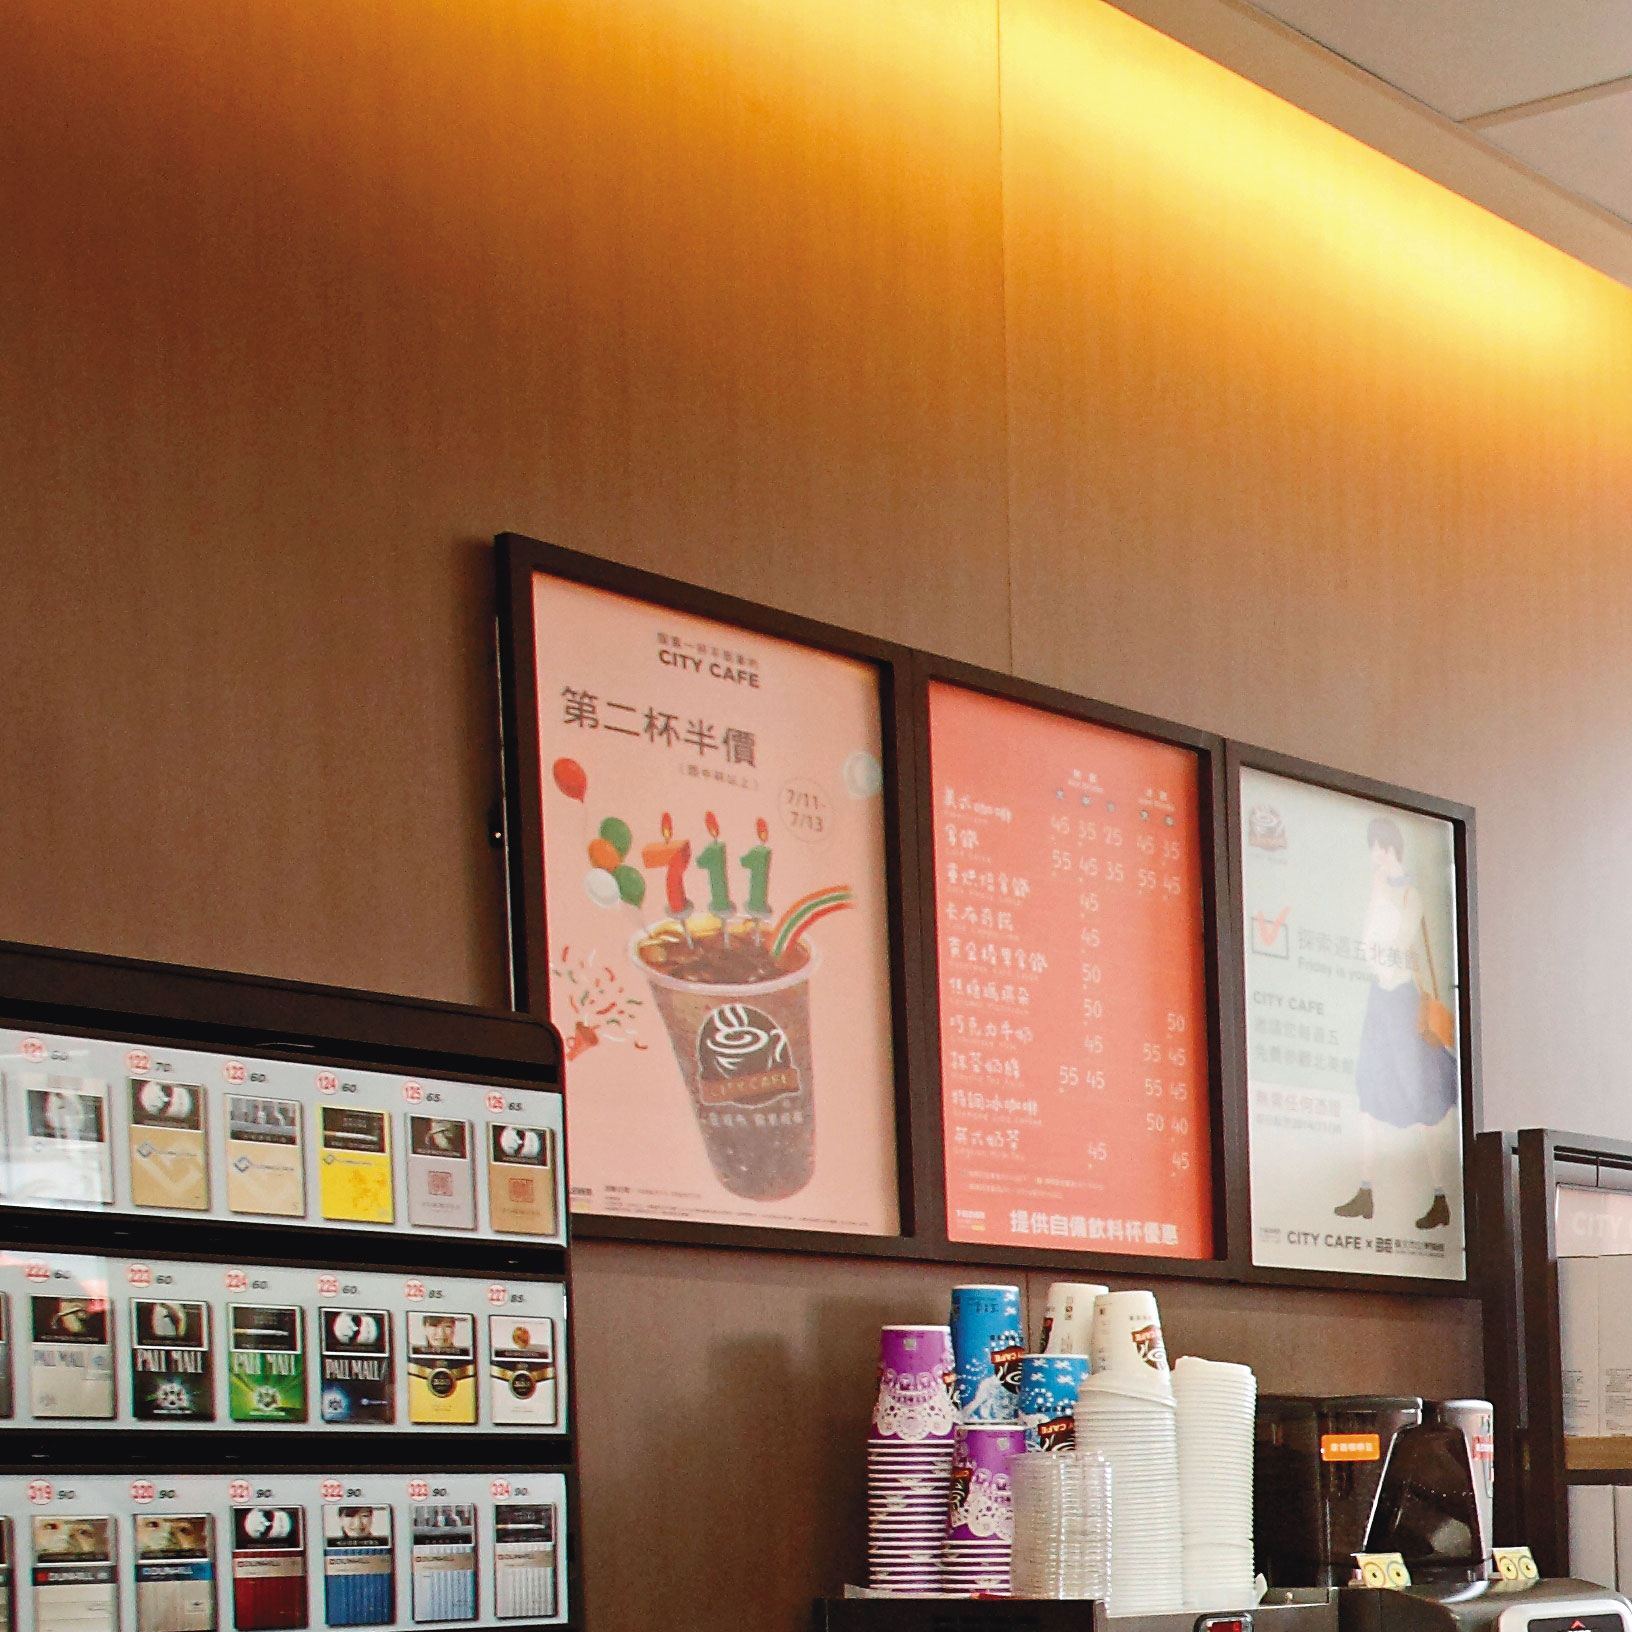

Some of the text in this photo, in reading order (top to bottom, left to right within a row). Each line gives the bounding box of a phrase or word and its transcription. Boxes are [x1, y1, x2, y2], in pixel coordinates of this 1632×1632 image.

[658, 649, 702, 673] CITY
[709, 662, 760, 689] CAFE
[561, 685, 757, 769] 第二杯半價
[1252, 990, 1325, 1017] CITY CAFE
[1059, 1064, 1080, 1087] 55
[1086, 1070, 1106, 1091] 45
[1009, 1208, 1180, 1247] 提供自備飲料杯優惠
[1571, 1211, 1623, 1240] CITY
[1287, 1230, 1362, 1251] CITY CAFE
[992, 1351, 1016, 1364] CAFE
[1040, 1422, 1068, 1435] CAFE
